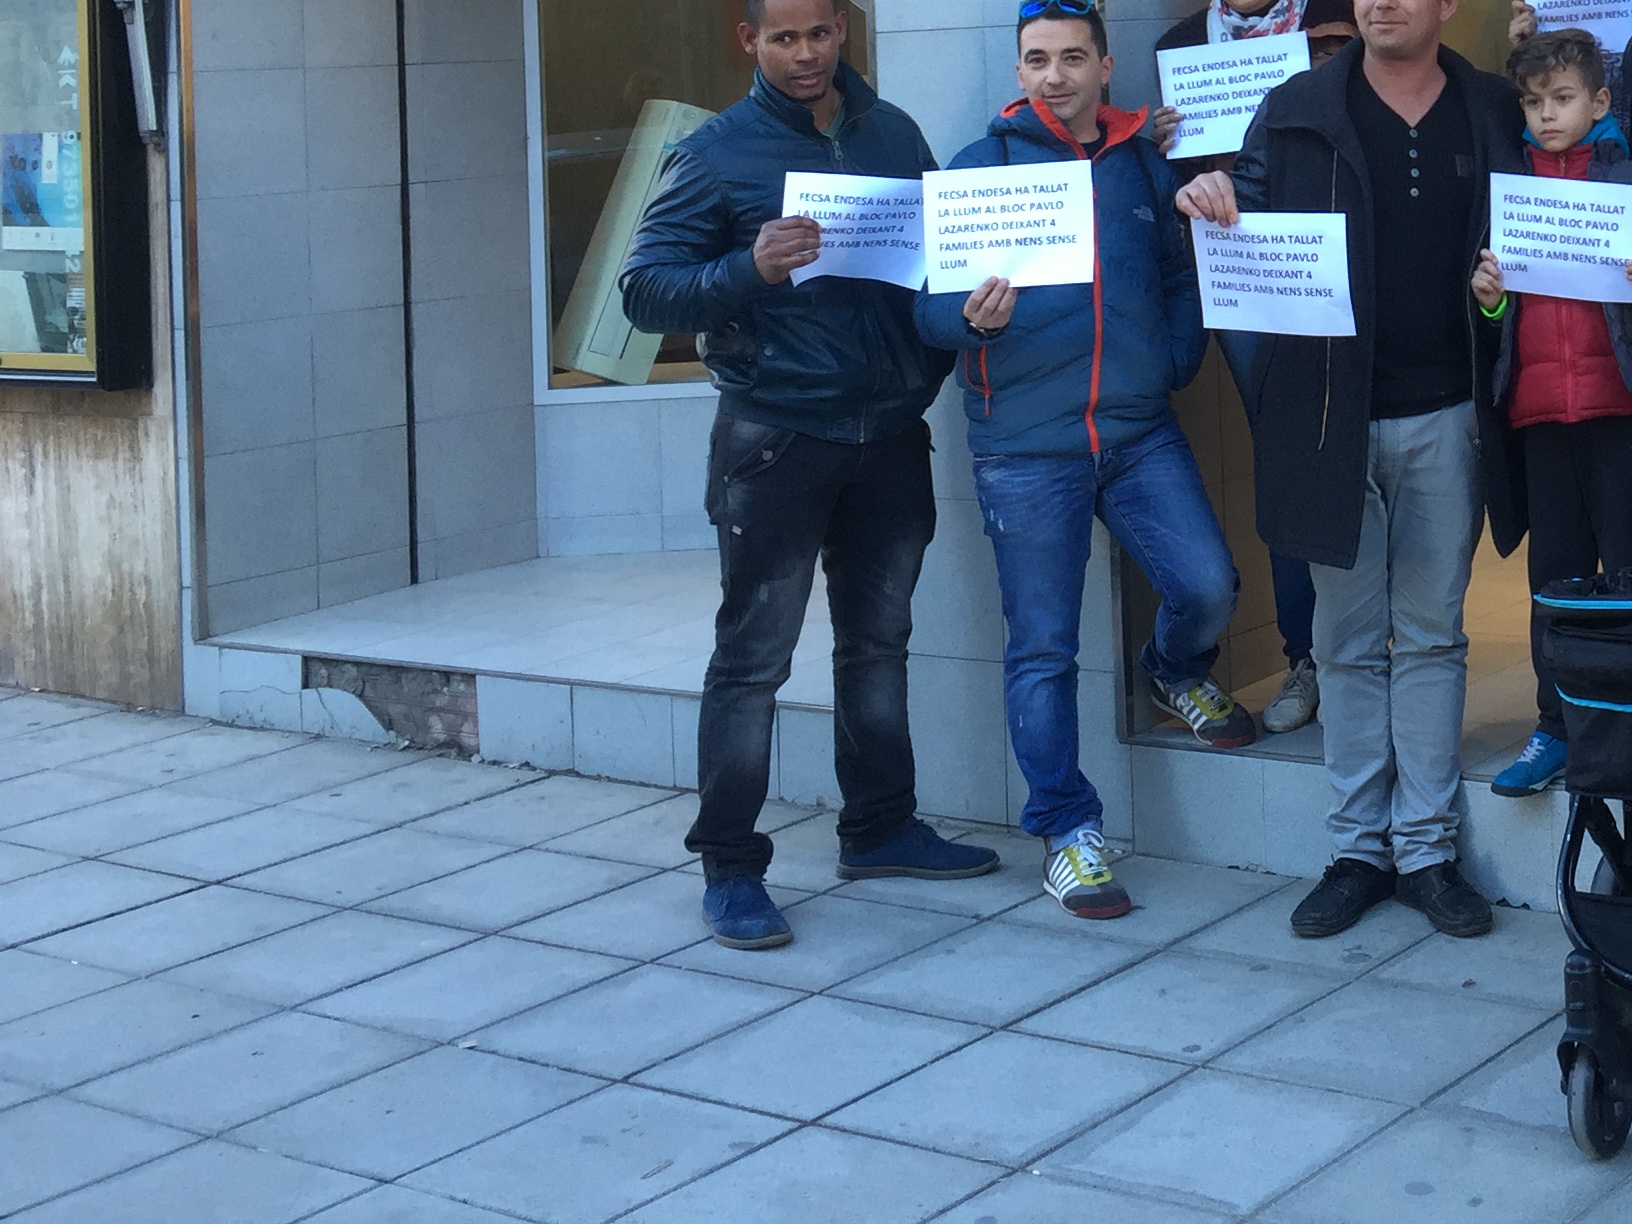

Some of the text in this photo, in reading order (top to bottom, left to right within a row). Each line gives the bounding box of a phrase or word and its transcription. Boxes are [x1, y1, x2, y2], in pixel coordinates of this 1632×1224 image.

[1172, 53, 1288, 76] FECSA ENDESA HA TALLAT
[1176, 93, 1229, 107] LAZARENKO
[938, 183, 1069, 200] FECSA ENDESA HA TALLAT
[938, 200, 1064, 217] LA LLUM AL BLOC PAVLO
[1504, 194, 1625, 215] FECSA ENDESA HA TALLAT
[939, 221, 998, 234] LAZARENKO
[1002, 219, 1046, 231] DEIXANT
[1504, 211, 1619, 231] LA LLUM AL BLOC PAVLO
[939, 234, 1077, 252] FAMILIES AMB NENS SENSE
[1206, 231, 1323, 244] FECSA ENDESA HA TALLAT
[1503, 228, 1557, 242] LAZARENKO
[1560, 235, 1602, 247] DEIXANT
[1208, 248, 1318, 262] LA LLUM AL BLOC PAVLO
[1502, 245, 1629, 267] FAMILIES AMB NENS SENSE
[940, 259, 968, 269] LLUM
[1210, 264, 1260, 277] LAZARENKO
[1263, 269, 1303, 279] DEIXANT
[1502, 262, 1528, 272] LLUM
[1212, 281, 1334, 297] FAMILIES AMB NENS SENSE
[1213, 298, 1238, 307] LLUM
